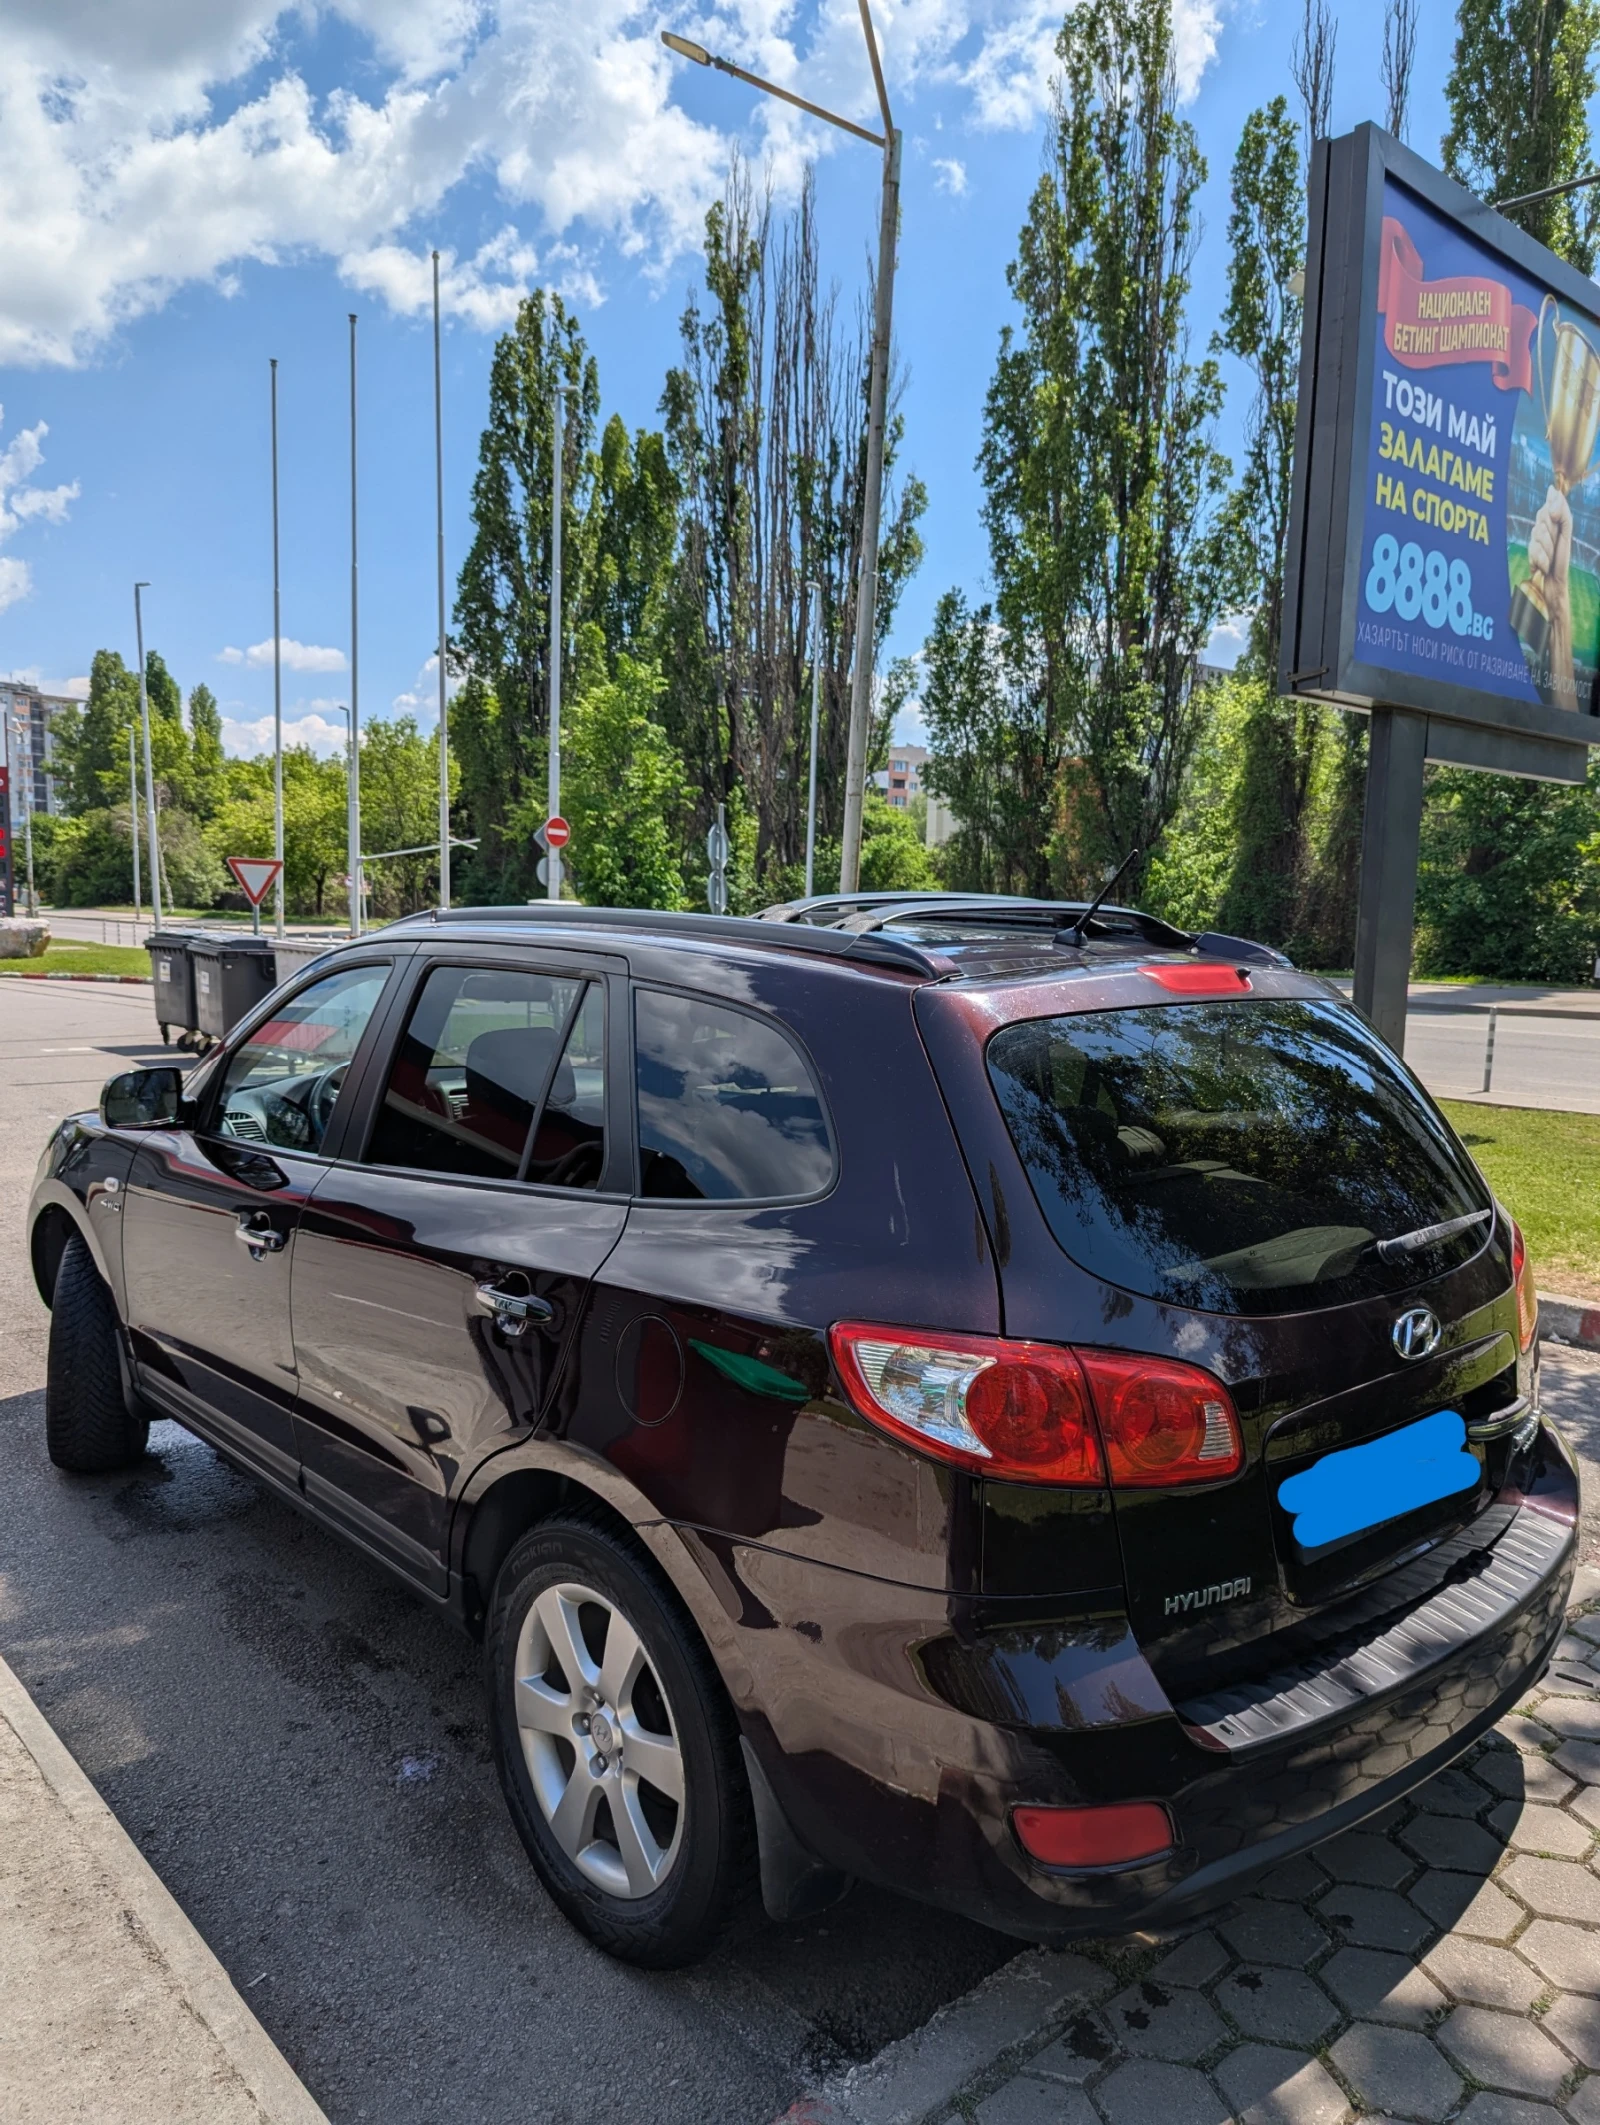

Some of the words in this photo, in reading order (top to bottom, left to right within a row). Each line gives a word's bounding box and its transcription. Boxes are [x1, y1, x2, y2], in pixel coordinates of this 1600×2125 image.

[1417, 291, 1492, 321] НАЦИОНАЛЕН
[1394, 322, 1439, 354] БЕТИНГ
[1440, 322, 1510, 353] ШАМПИОНАТ
[1382, 369, 1442, 433] ТОЗИ
[1448, 403, 1497, 459] МАЙ
[1378, 421, 1495, 503] ЗАЛАГАМЕ
[1375, 472, 1408, 515] НА
[1412, 488, 1490, 546] СПОРТА
[1357, 620, 1410, 653] ХАЗАРТЪТ
[1412, 635, 1438, 660] НОСИ
[1440, 643, 1465, 667] РИСК
[1467, 650, 1480, 670] ОТ
[1480, 653, 1529, 684] РАЗВИВАНЕ
[1530, 667, 1541, 687] НА
[100, 1198, 122, 1213] 4WD
[1164, 1576, 1251, 1616] HYUNDAI
